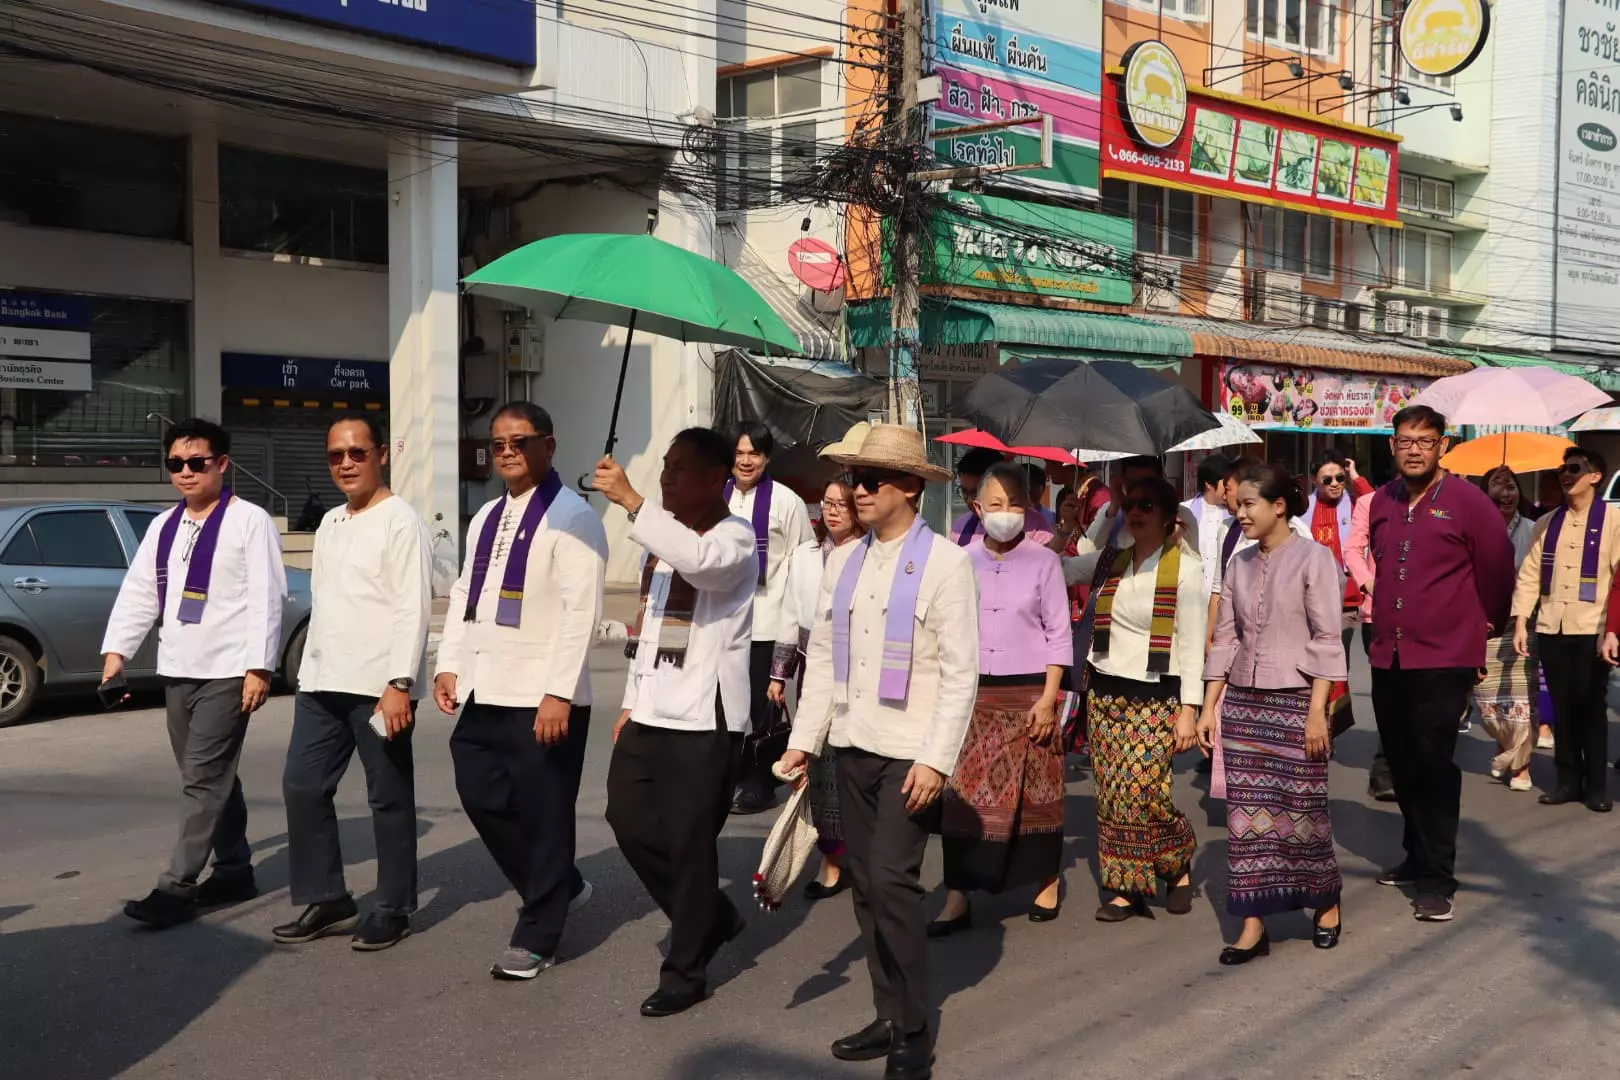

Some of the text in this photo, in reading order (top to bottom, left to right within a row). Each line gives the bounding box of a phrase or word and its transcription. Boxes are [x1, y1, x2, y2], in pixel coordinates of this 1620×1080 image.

[1007, 36, 1047, 72] ผื่นคัน
[950, 134, 1015, 166] โรคทั่วไป
[1118, 149, 1185, 172] 066-095-2133
[2, 306, 68, 319] Bangkok Bank
[282, 360, 366, 377] เข้า ที่จอดรถ
[37, 375, 65, 385] Center
[284, 375, 370, 390] In Car park
[1231, 404, 1243, 416] 99
